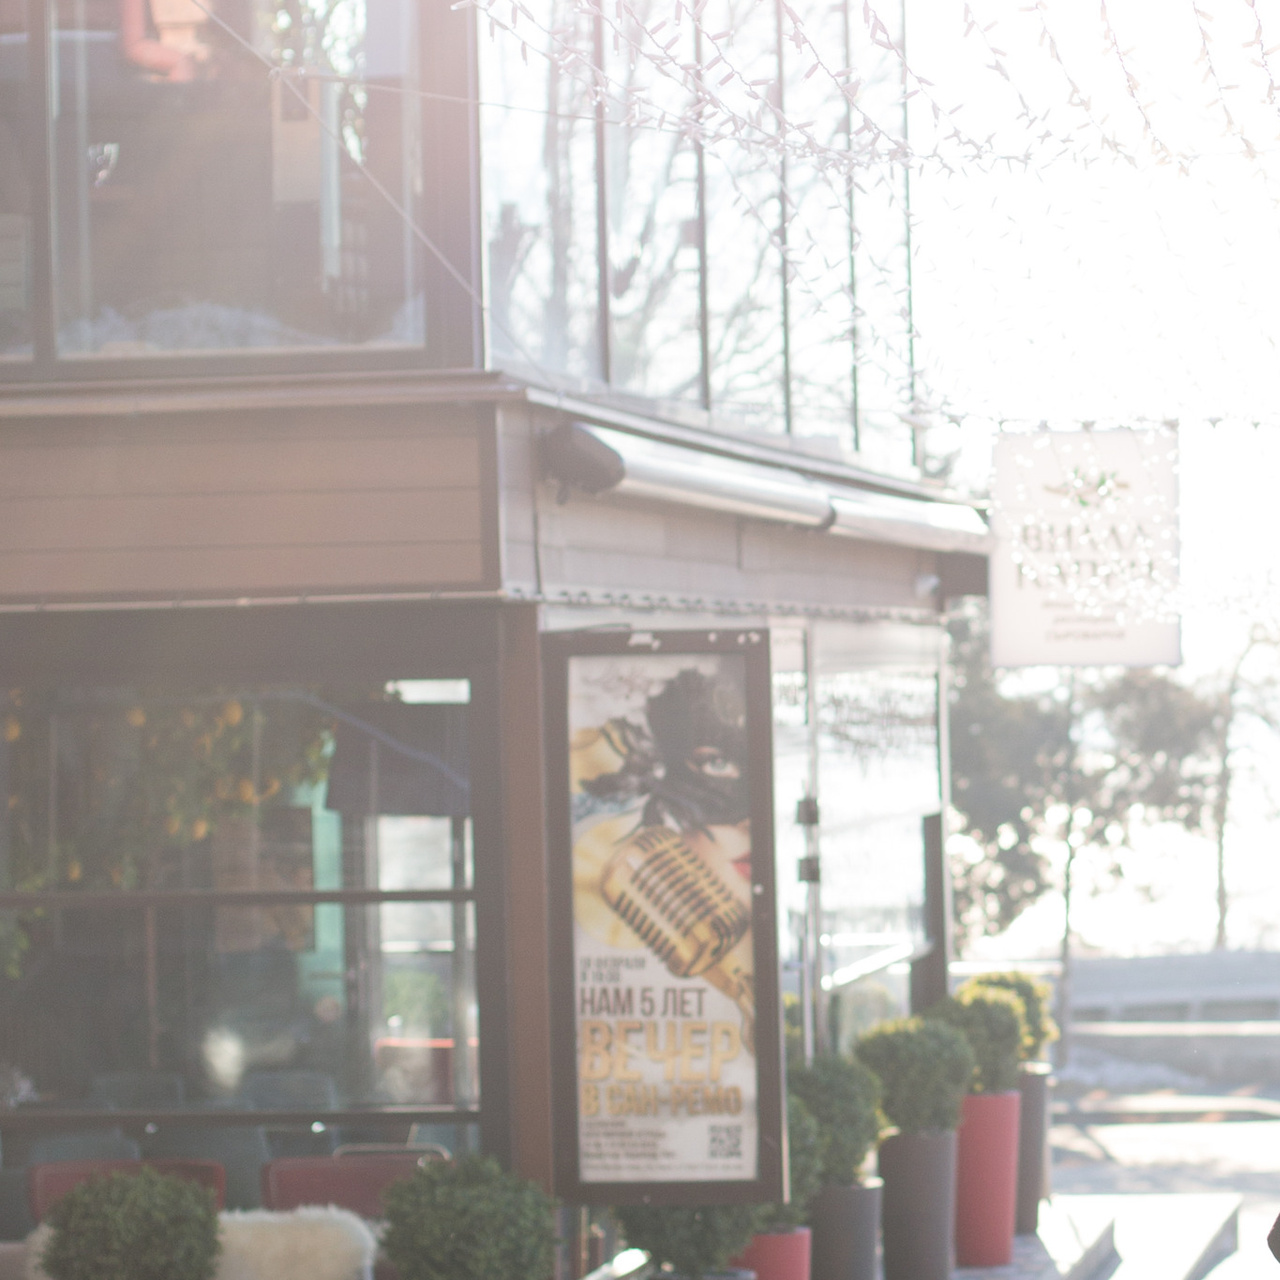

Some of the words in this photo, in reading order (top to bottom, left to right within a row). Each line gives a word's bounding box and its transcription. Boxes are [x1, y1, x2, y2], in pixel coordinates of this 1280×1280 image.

[579, 987, 634, 1016] НАМ
[639, 987, 656, 1017] 5
[661, 987, 707, 1018] ЛЕТ
[579, 1021, 741, 1083] ВЕЧЕР
[579, 1084, 600, 1117] В
[605, 1085, 744, 1117] САН-РЕМО
